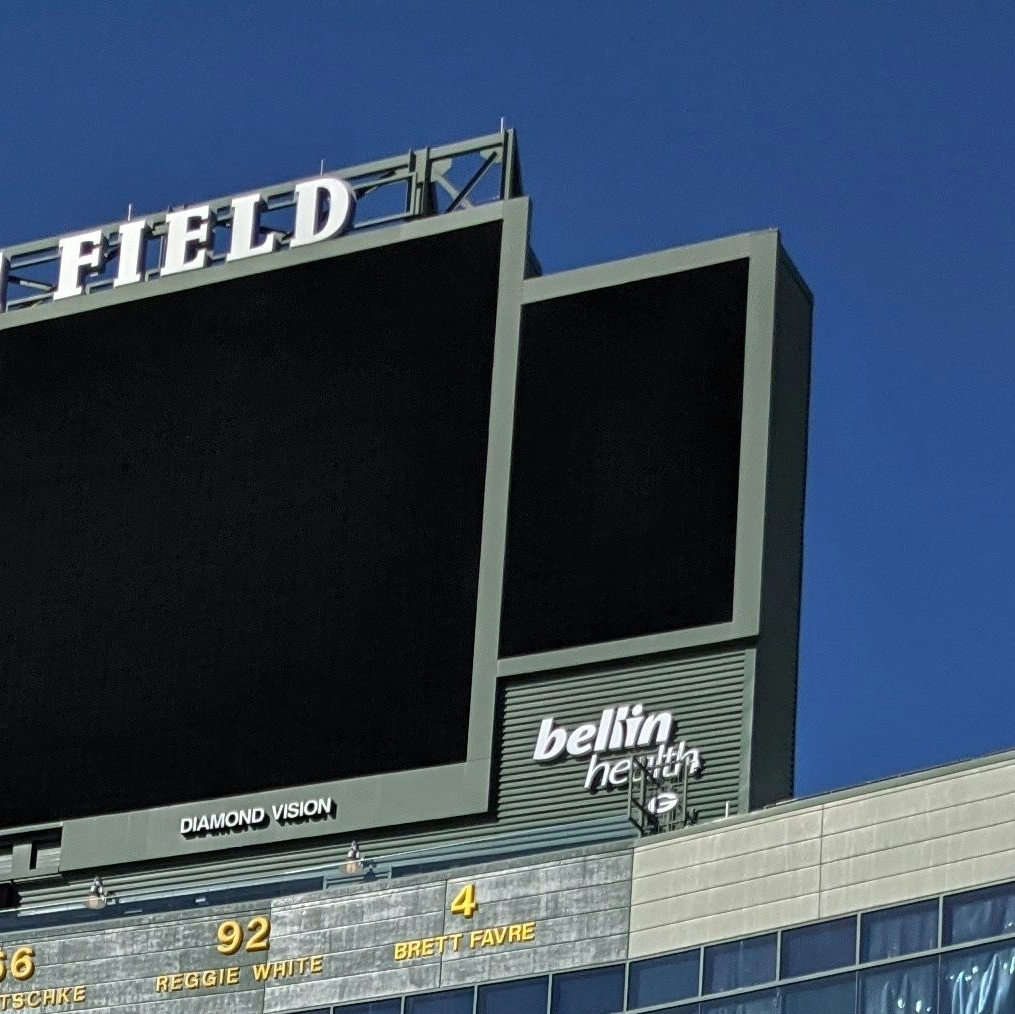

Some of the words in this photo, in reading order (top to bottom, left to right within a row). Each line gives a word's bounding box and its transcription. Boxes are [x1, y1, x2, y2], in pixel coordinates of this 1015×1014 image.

[54, 177, 353, 300] FIELD
[533, 704, 673, 761] bellin
[180, 807, 265, 834] DIAMOND
[272, 799, 332, 820] VISION
[450, 883, 479, 919] 4
[216, 915, 271, 956] 92
[394, 932, 464, 961] BRETT
[470, 921, 536, 950] FAVRE
[155, 965, 240, 993] REGGIE
[253, 955, 324, 982] WHITE
